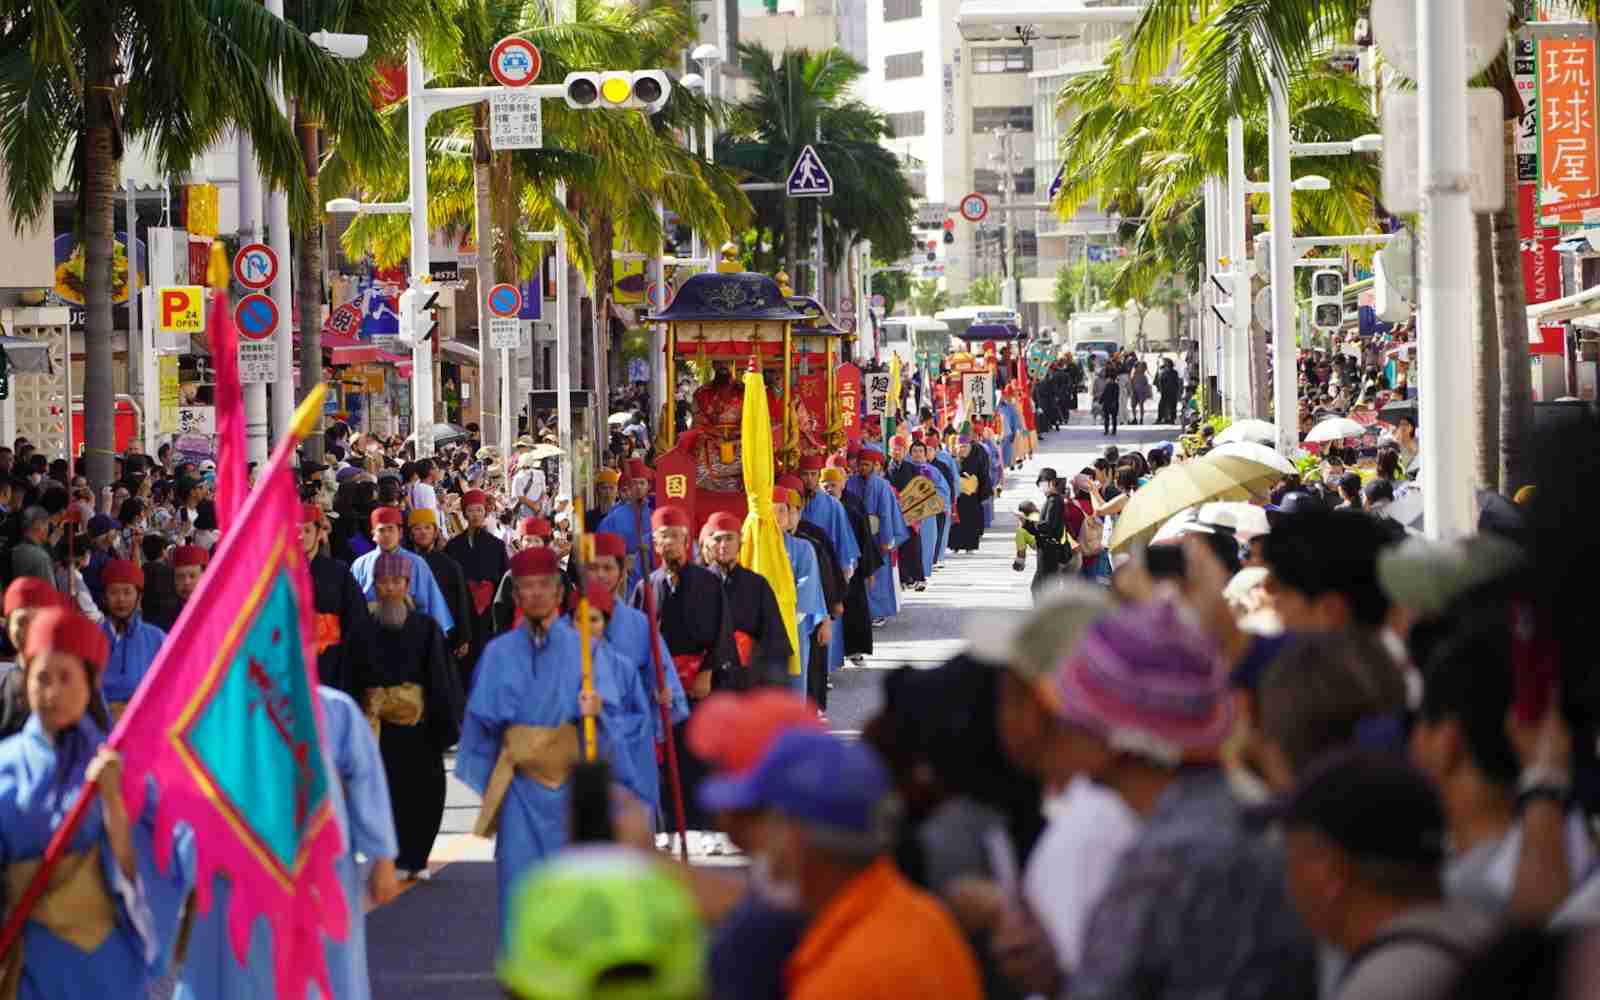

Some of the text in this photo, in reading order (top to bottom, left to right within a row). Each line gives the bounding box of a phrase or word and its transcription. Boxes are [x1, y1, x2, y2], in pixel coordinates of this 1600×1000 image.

[1545, 41, 1592, 181] 琉球屋
[1535, 243, 1545, 300] MANGO
[163, 291, 190, 327] P
[176, 320, 199, 328] OPEN
[186, 310, 197, 319] 24
[839, 381, 856, 426] 三司官
